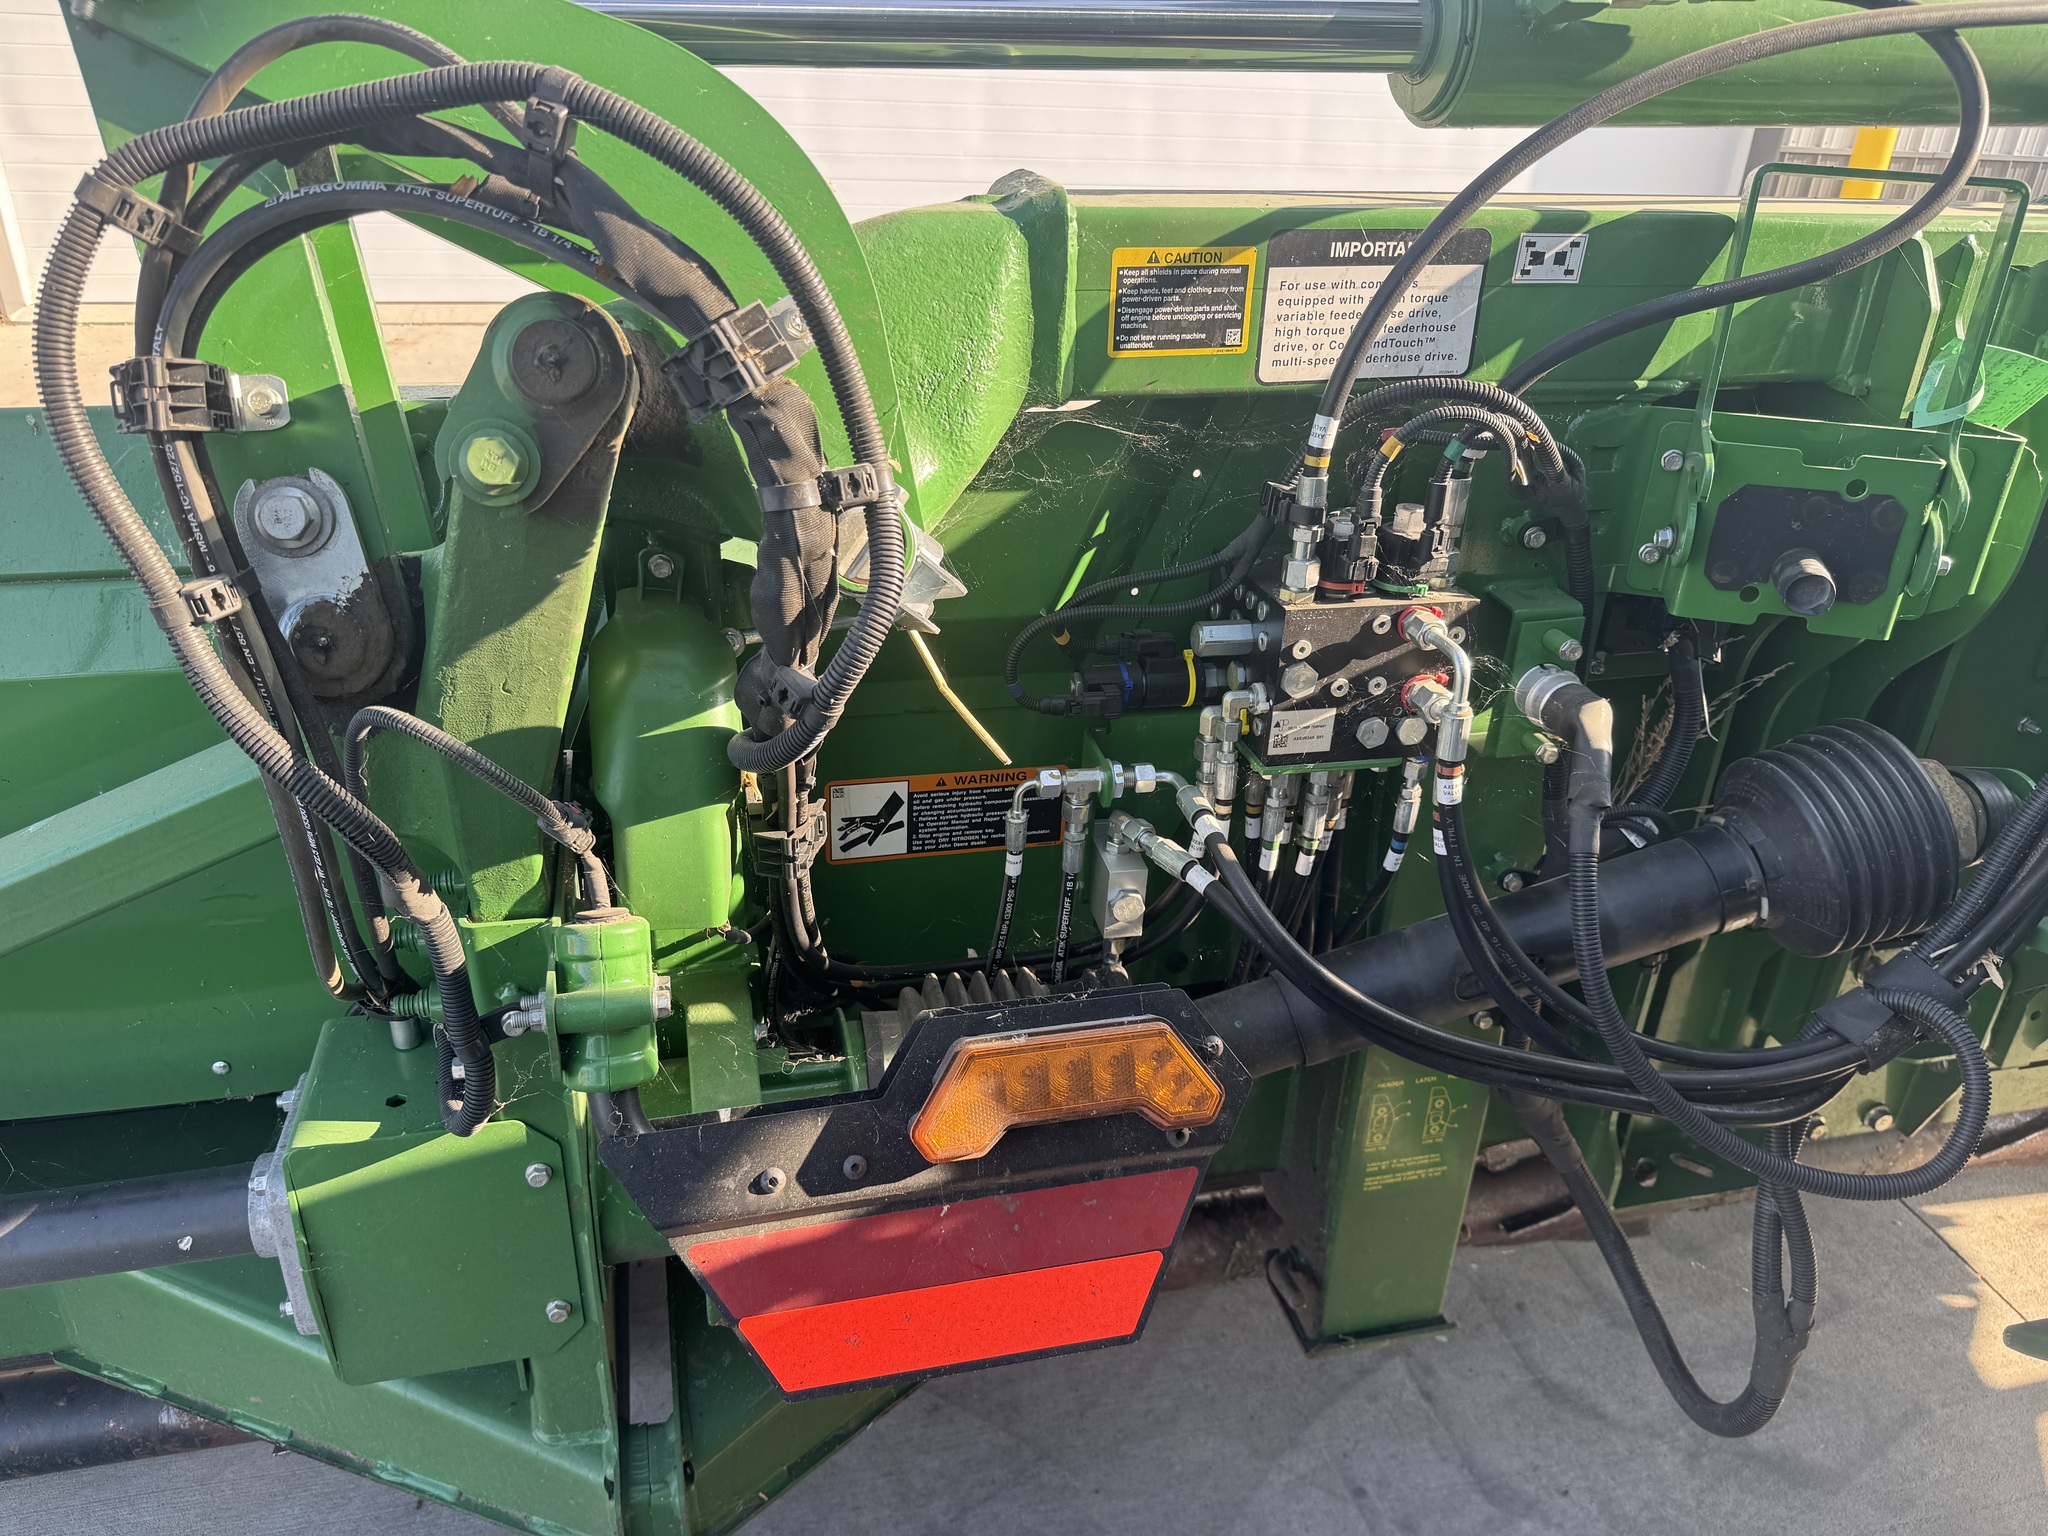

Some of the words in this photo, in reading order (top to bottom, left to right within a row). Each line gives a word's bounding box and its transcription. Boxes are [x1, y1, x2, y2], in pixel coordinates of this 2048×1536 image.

[279, 180, 387, 203] ALFAGOMMA
[435, 191, 520, 225] SUPERTUFF
[1330, 241, 1413, 258] IMPORTA
[1165, 252, 1222, 264] CAUTION
[1181, 268, 1197, 276] place
[1199, 268, 1218, 276] during
[1123, 277, 1157, 285] operations.
[1279, 280, 1299, 291] For
[1305, 282, 1326, 290] use
[1331, 280, 1355, 289] with
[1278, 295, 1334, 307] equipped
[1339, 295, 1363, 304] with
[1411, 294, 1448, 304] torque
[1122, 307, 1153, 315] Disengage
[1155, 306, 1192, 314] power-driven
[1173, 313, 1206, 321] unclogging
[1215, 312, 1241, 320] servicing
[1277, 311, 1325, 322] variable
[1409, 308, 1441, 319] drive,
[1181, 332, 1206, 340] machine
[1275, 326, 1301, 339] high
[1306, 325, 1345, 337] torque
[1384, 323, 1456, 334] feederhouse
[1273, 341, 1307, 354] drive,
[1312, 343, 1324, 351] or
[1424, 351, 1457, 361] drive.
[188, 514, 208, 553] MSHA
[954, 771, 1027, 786] WARNING
[1445, 817, 1458, 847] ITALY
[1454, 855, 1464, 868] IN
[1458, 873, 1475, 900] MADE
[1060, 897, 1072, 939] SUPERTUFF
[1001, 920, 1010, 935] MPa
[998, 935, 1006, 948] 22.5
[995, 949, 1003, 959] WP
